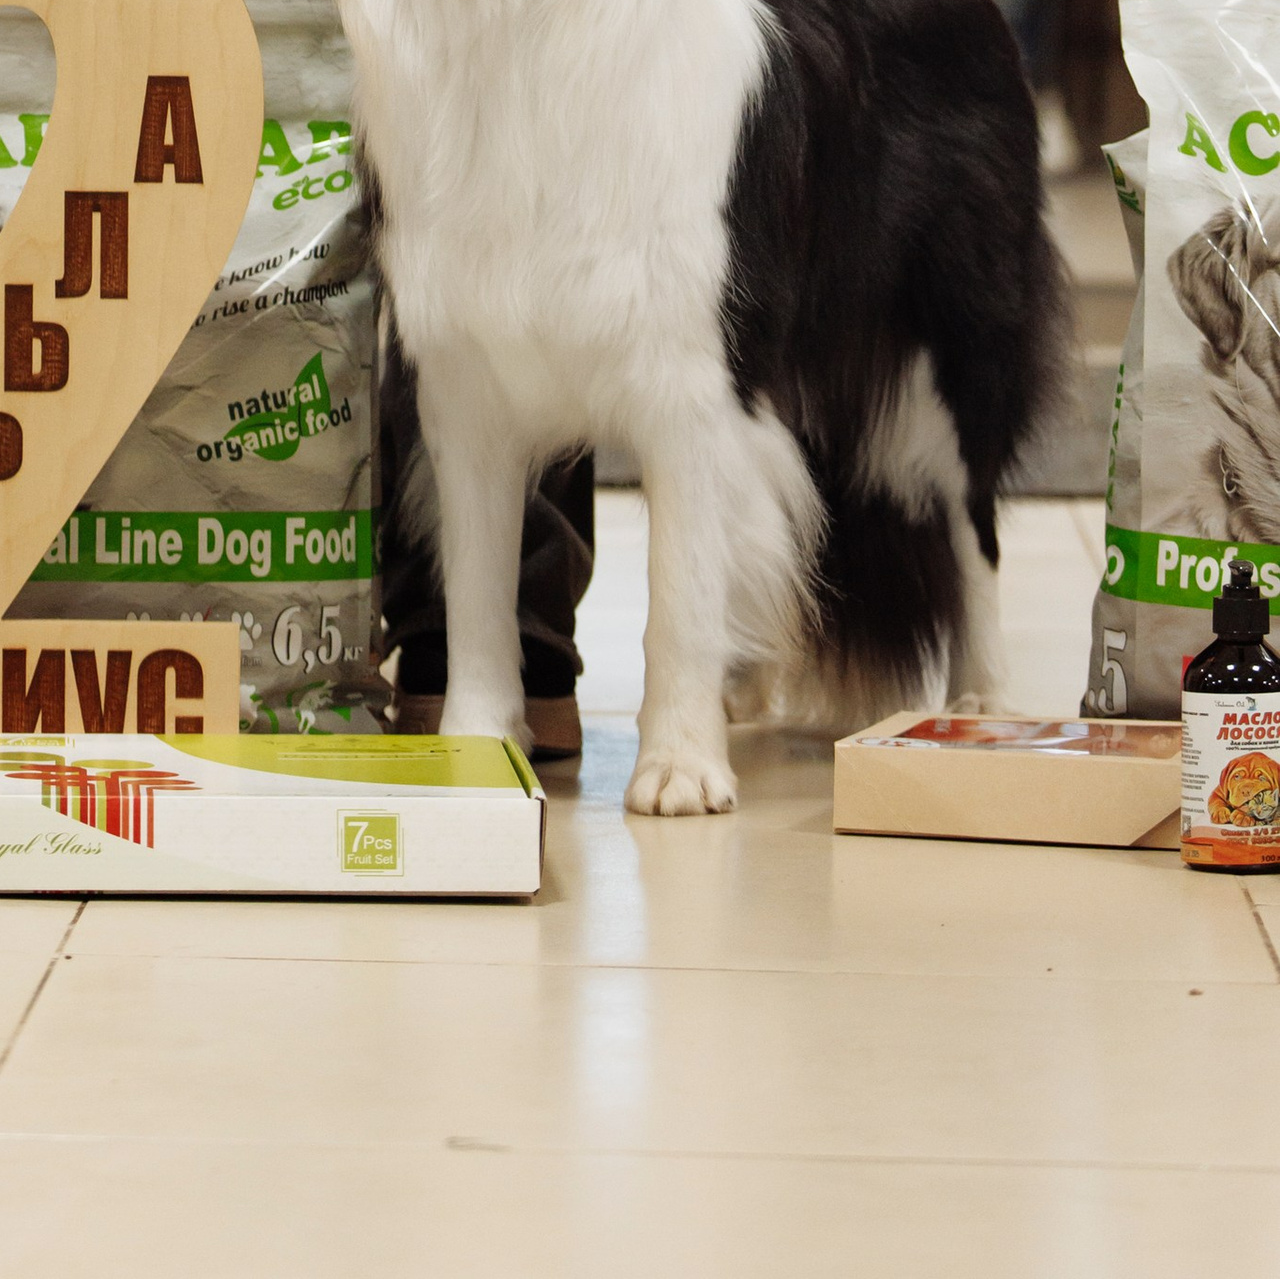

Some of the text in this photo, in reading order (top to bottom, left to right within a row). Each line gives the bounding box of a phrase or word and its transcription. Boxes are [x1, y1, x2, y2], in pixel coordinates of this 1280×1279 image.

[272, 170, 353, 211] eco
[229, 255, 283, 286] know
[211, 299, 250, 322] rise
[254, 294, 268, 311] a
[272, 278, 350, 307] champion
[227, 373, 322, 421] natural
[196, 397, 352, 463] organic food
[95, 517, 184, 565] Line
[197, 517, 272, 578] Dog
[285, 515, 357, 566] Food
[1222, 710, 1280, 726] МАСЛО
[43, 832, 104, 855] Glass
[347, 853, 395, 865] Fruit Set
